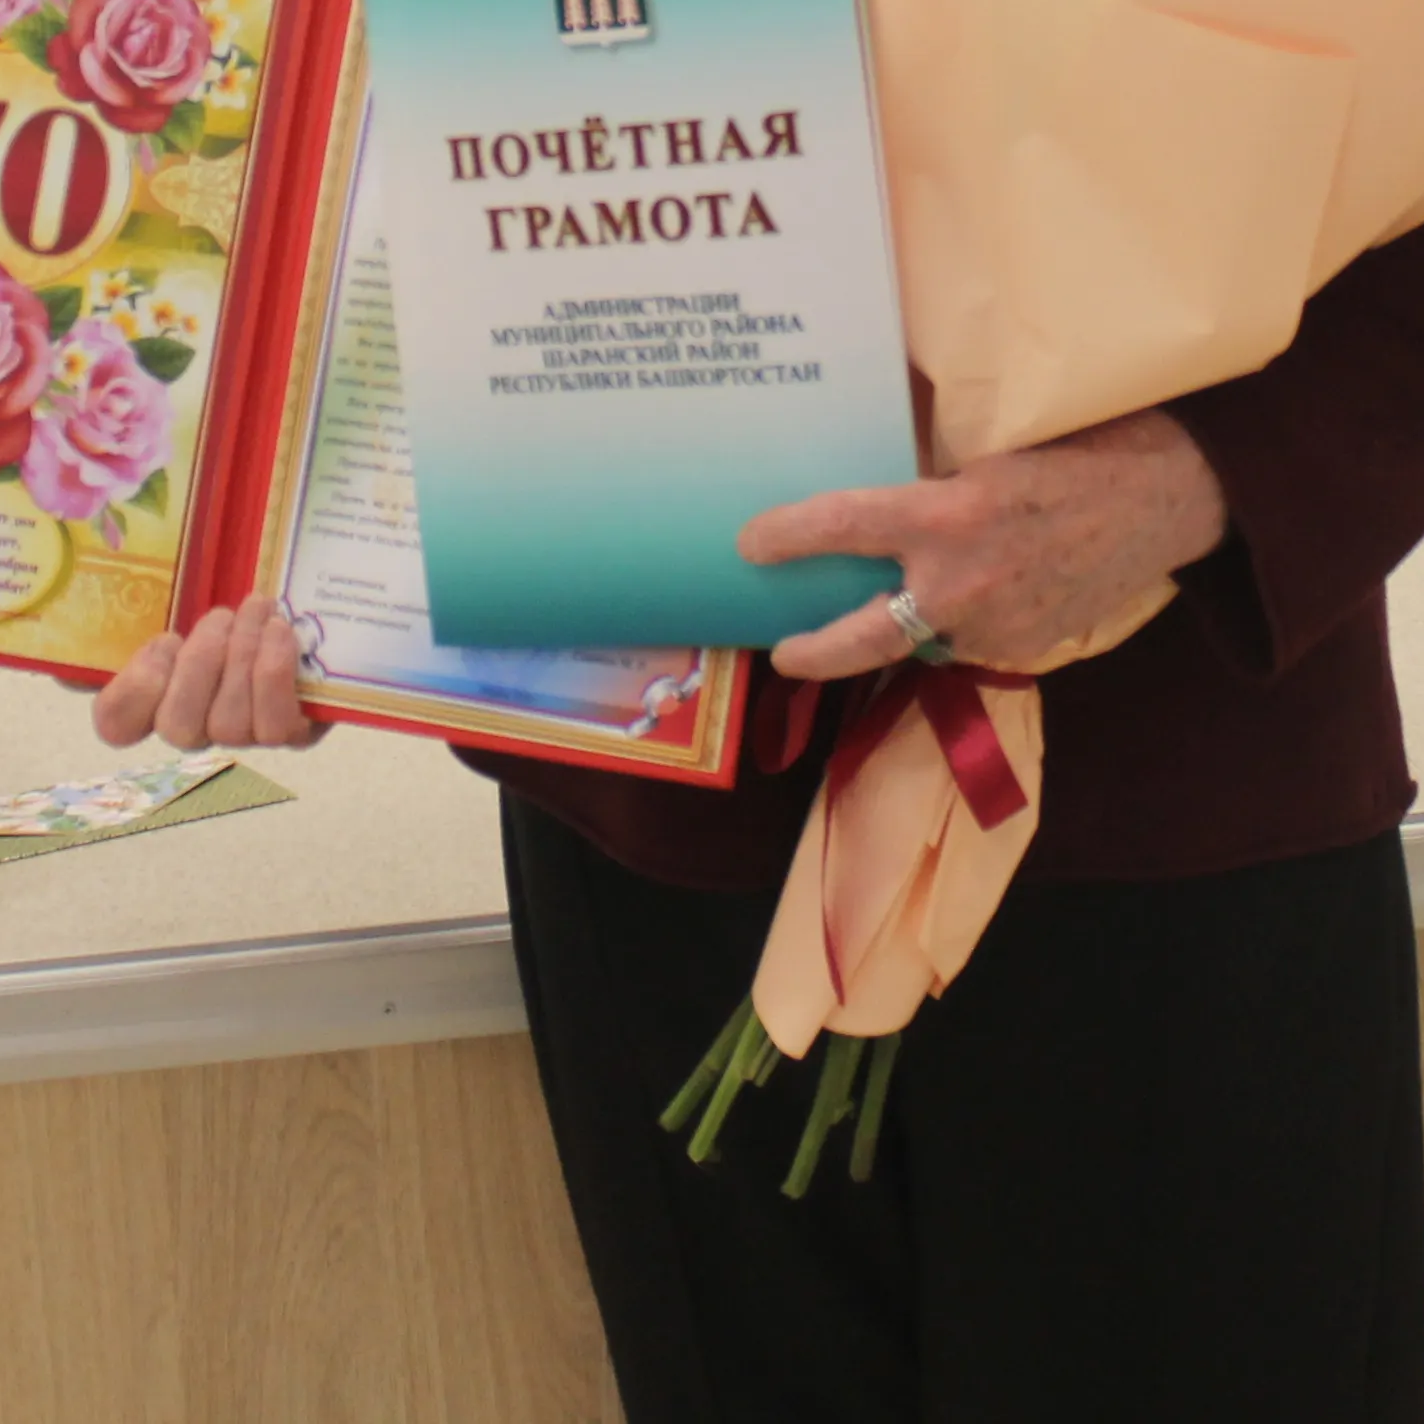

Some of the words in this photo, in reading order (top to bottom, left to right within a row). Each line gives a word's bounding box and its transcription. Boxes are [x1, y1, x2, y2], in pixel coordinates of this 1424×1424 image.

[445, 108, 804, 181] ПОЧЁТНАЯ
[484, 189, 782, 253] ГРАМОТА
[543, 292, 741, 324] АДМИНИСТРАЦИИ
[490, 317, 706, 348] МУНИЦИПАЛЬНОГО
[709, 312, 806, 337] РАЙОНА
[541, 340, 682, 369] ШАРАНСКИЙ
[686, 340, 761, 365] РАЙОН
[489, 370, 630, 396] РЕСПУБЛИКИ
[634, 361, 823, 390] БАШКОРТОСТАН
